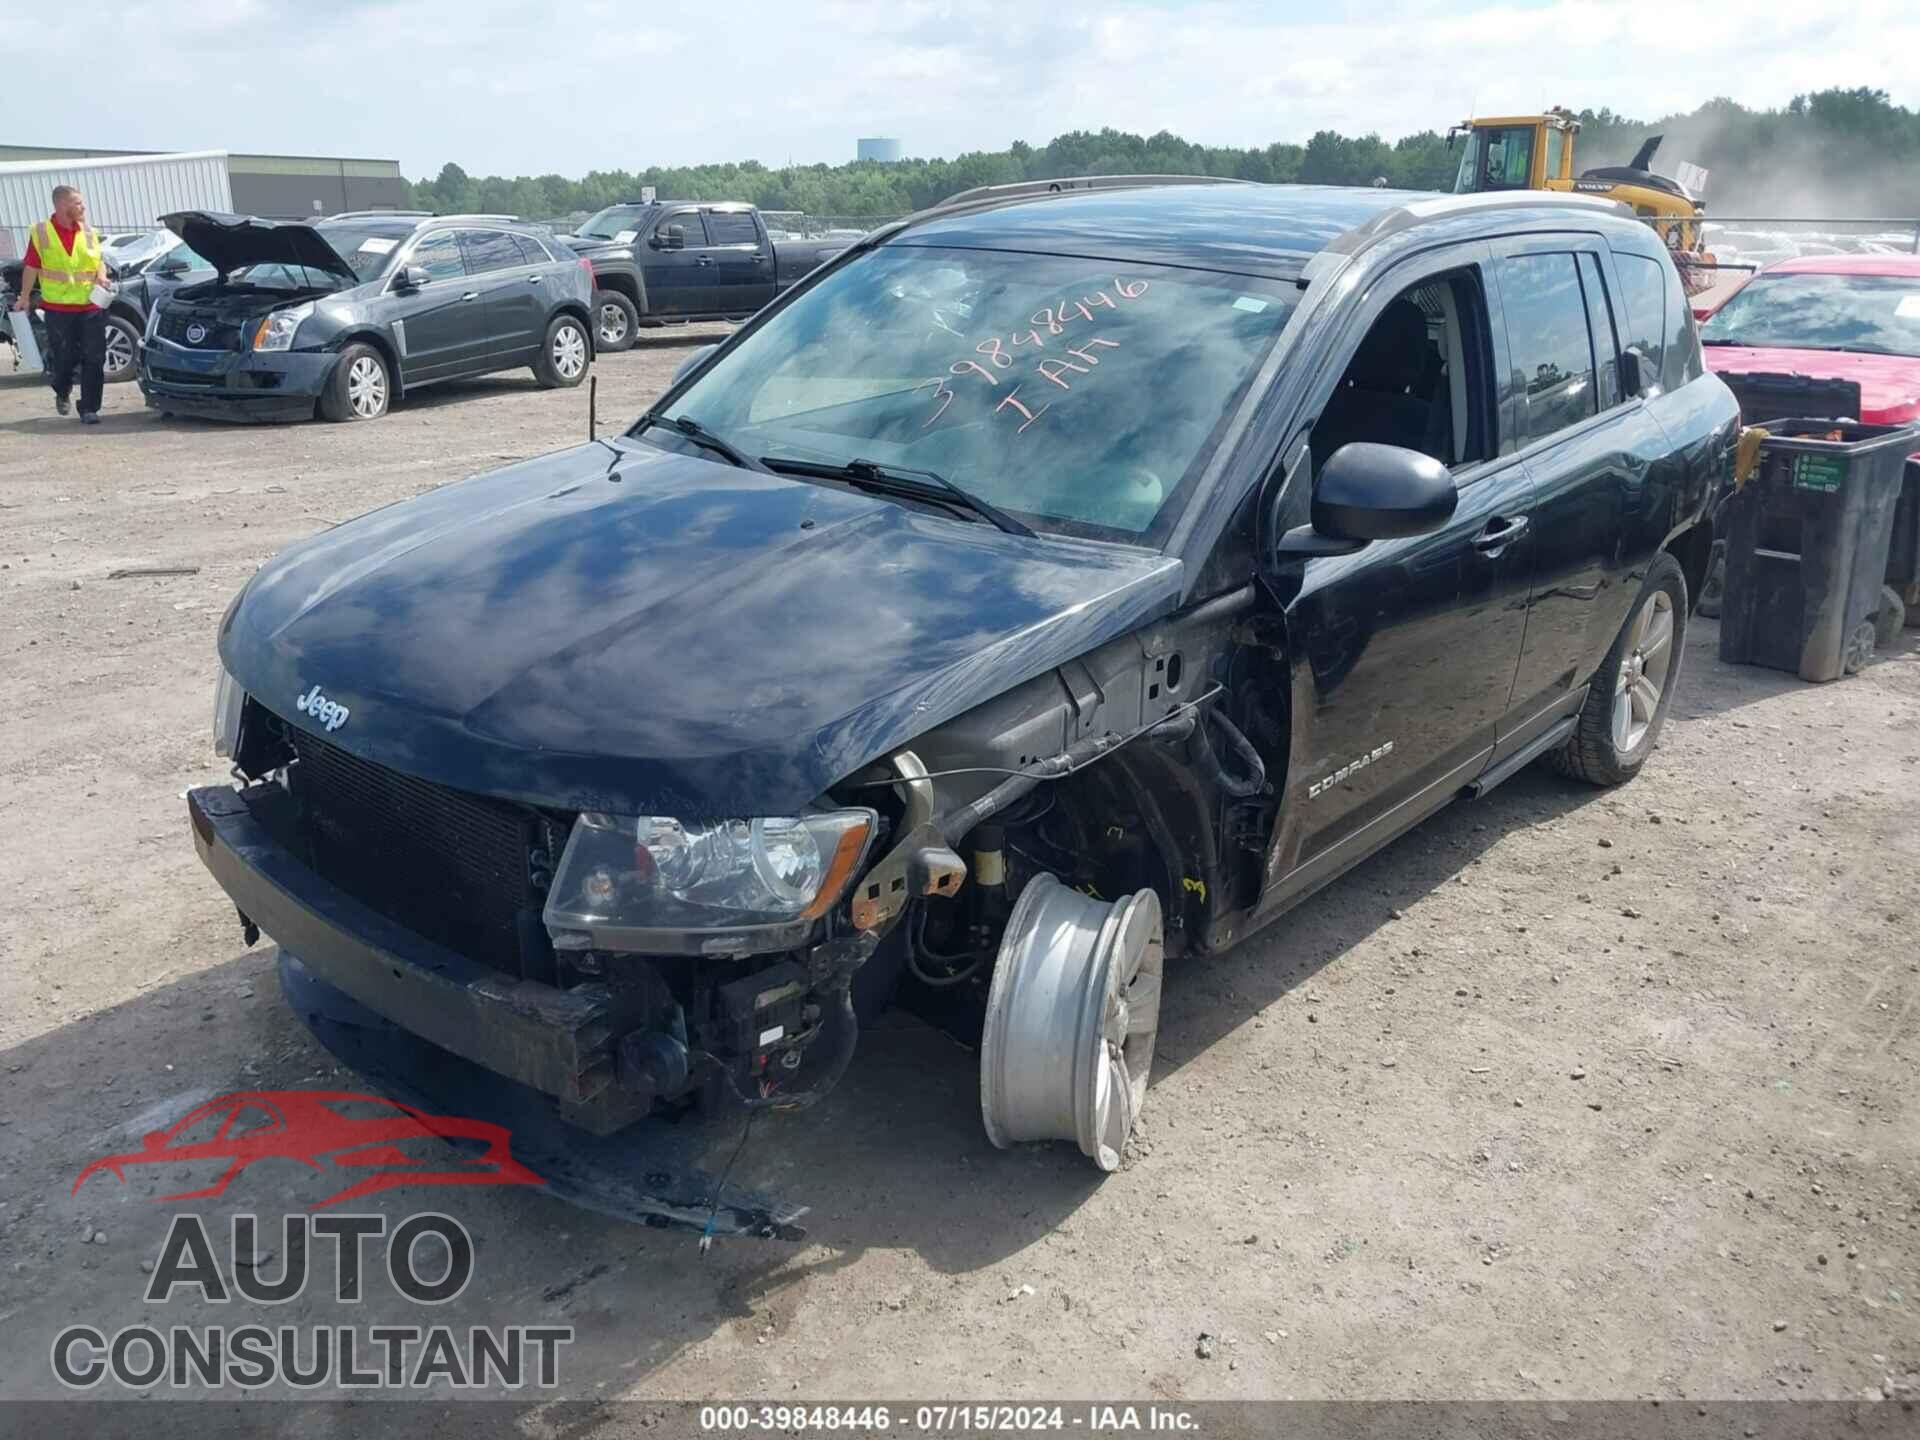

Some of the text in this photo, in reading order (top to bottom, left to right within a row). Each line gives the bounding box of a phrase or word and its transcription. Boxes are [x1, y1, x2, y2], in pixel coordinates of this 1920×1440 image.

[911, 278, 1149, 428] 39848446
[297, 684, 350, 732] Jeep
[1309, 741, 1393, 800] COMPASS
